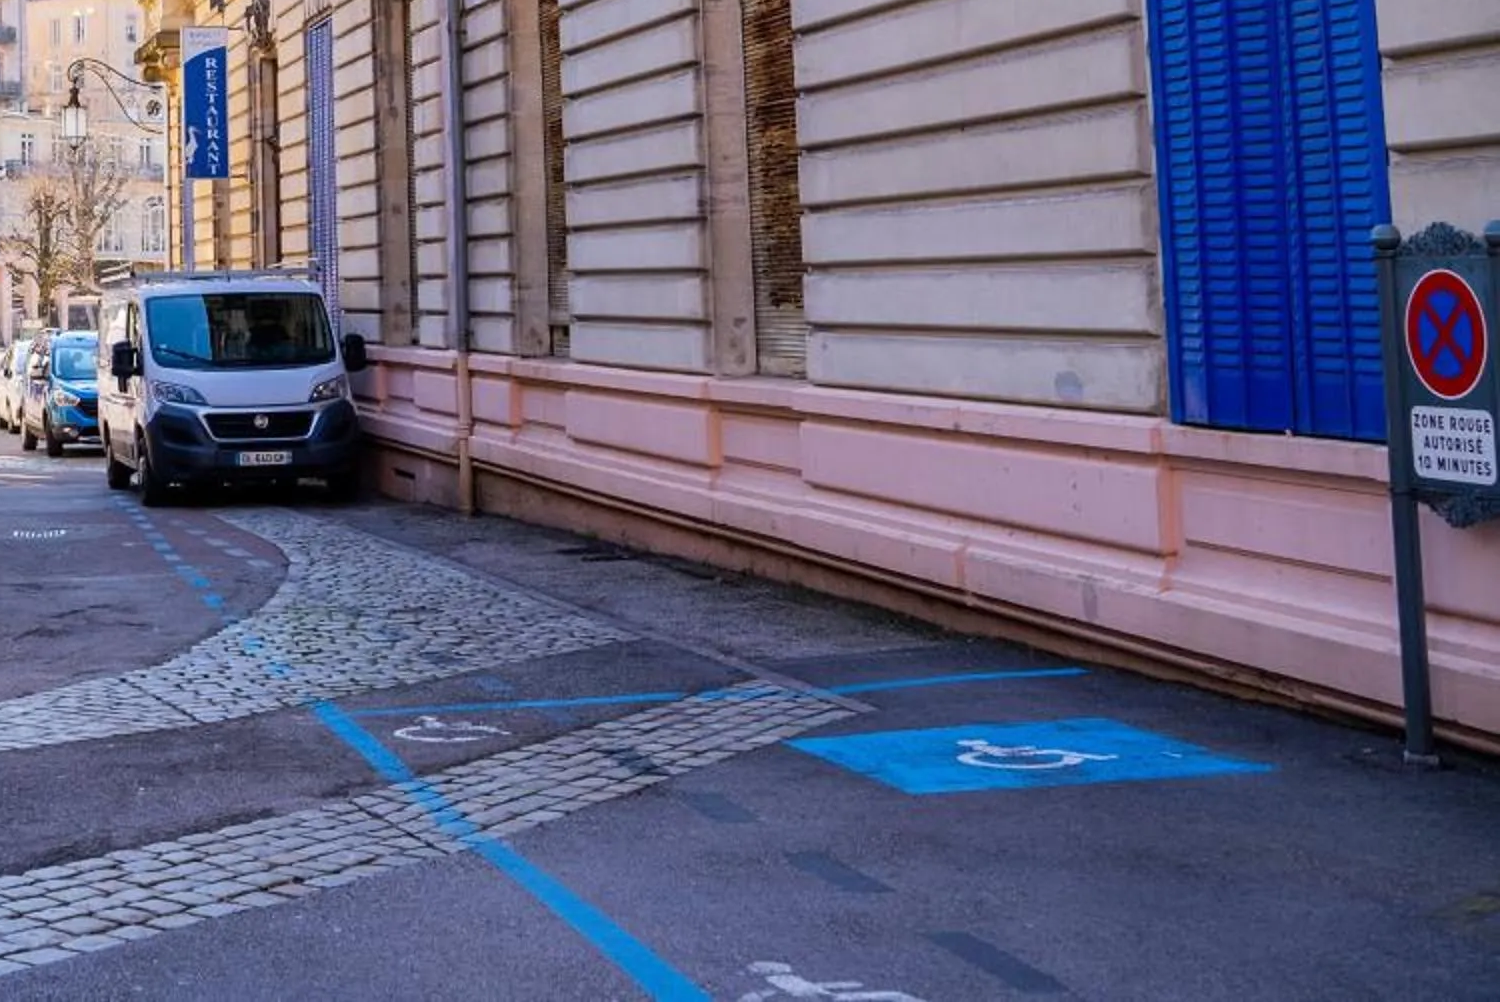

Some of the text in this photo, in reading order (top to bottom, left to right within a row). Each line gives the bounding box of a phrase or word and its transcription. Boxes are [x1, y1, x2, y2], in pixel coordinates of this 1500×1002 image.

[204, 56, 221, 175] RESTAURANT
[1413, 413, 1491, 433] ZONE ROUGE
[1418, 455, 1492, 476] 10 MINUTES
